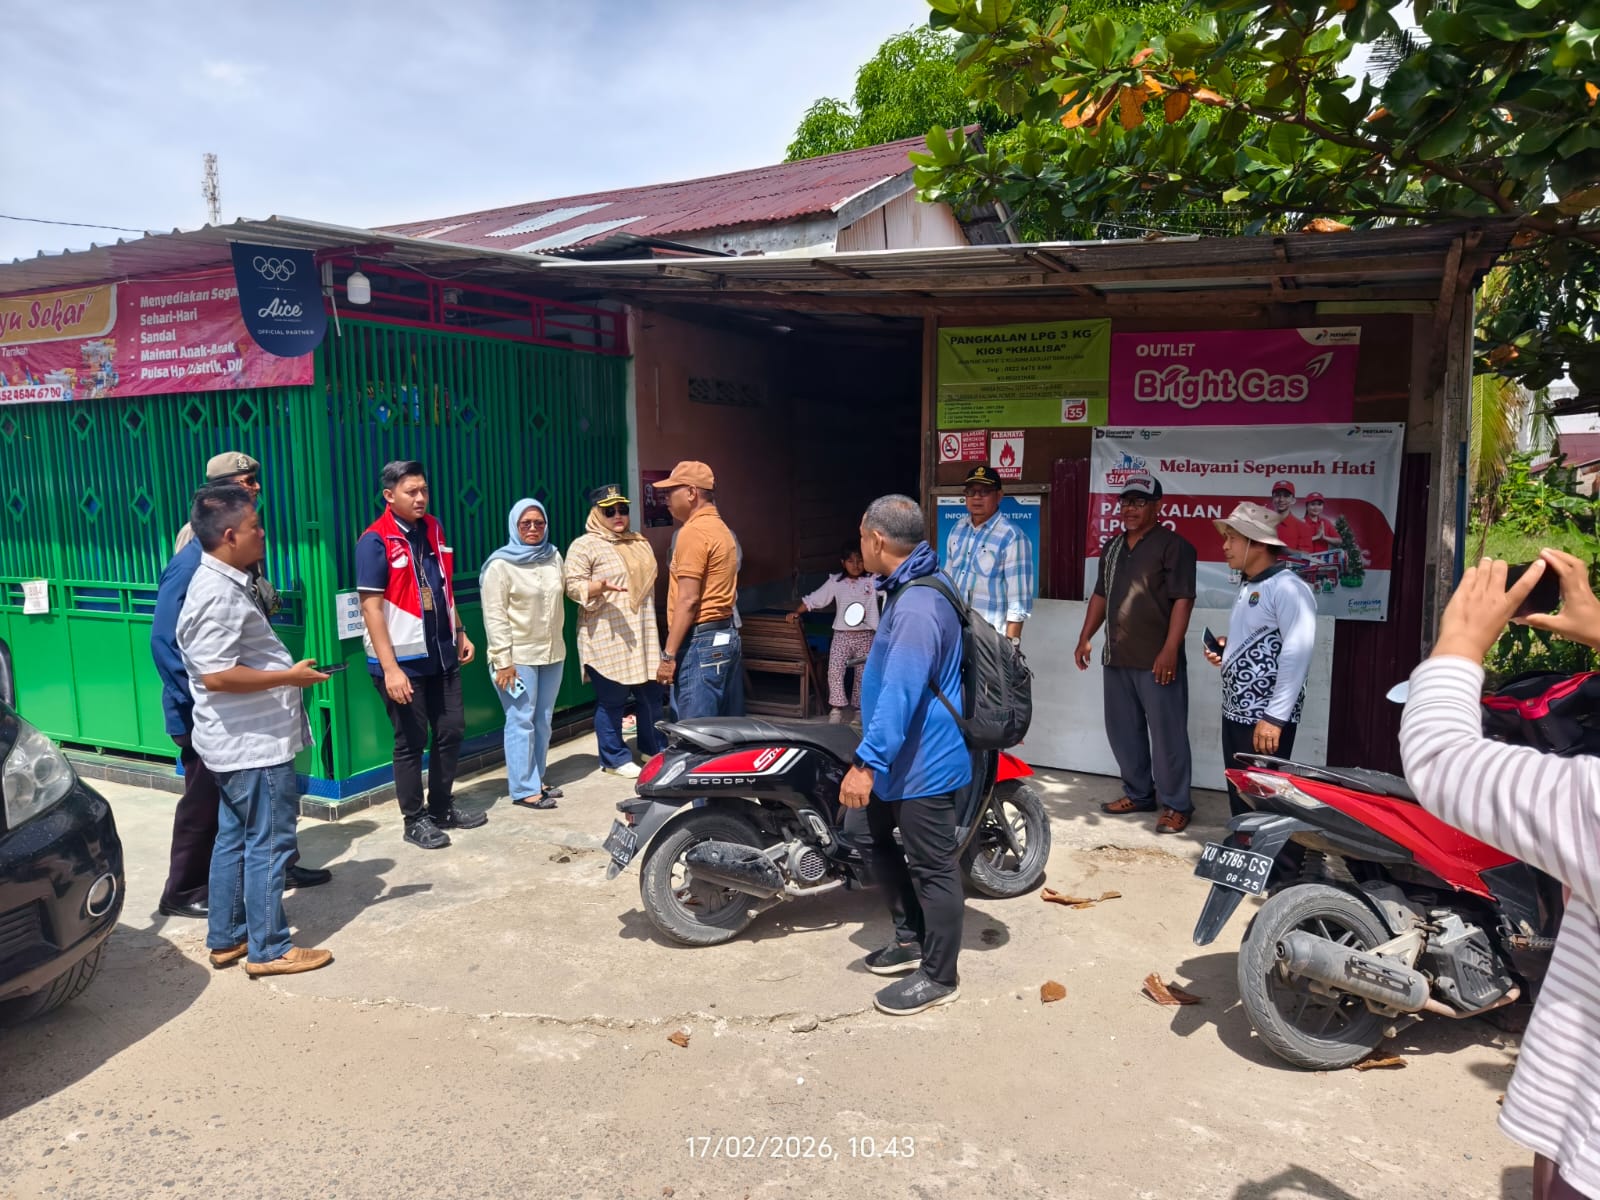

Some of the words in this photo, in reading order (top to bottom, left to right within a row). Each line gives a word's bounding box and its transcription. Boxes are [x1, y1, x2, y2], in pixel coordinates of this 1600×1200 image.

[140, 291, 208, 308] Menyediakan
[258, 297, 303, 318] Aice
[140, 308, 198, 326] Sehari-Hari
[140, 330, 176, 344] Sandal
[951, 334, 1027, 344] PANGKALAN
[1031, 331, 1057, 340] LPG
[1060, 330, 1068, 339] 3
[1072, 329, 1091, 338] KG
[141, 347, 178, 361] Mainan
[180, 342, 235, 358] Anak-Anak
[976, 347, 1003, 356] KIOS
[1136, 343, 1196, 357] OUTLET
[141, 366, 169, 379] Pulsa
[1135, 364, 1236, 408] Bright
[1238, 368, 1309, 402] Gas
[1066, 408, 1083, 418] 135
[1160, 459, 1239, 477] Melayani
[1243, 460, 1325, 477] Sepenuh
[1331, 460, 1376, 475] Hati
[1202, 846, 1218, 861] KU
[1219, 851, 1246, 868] 5786
[1248, 857, 1268, 875] CS
